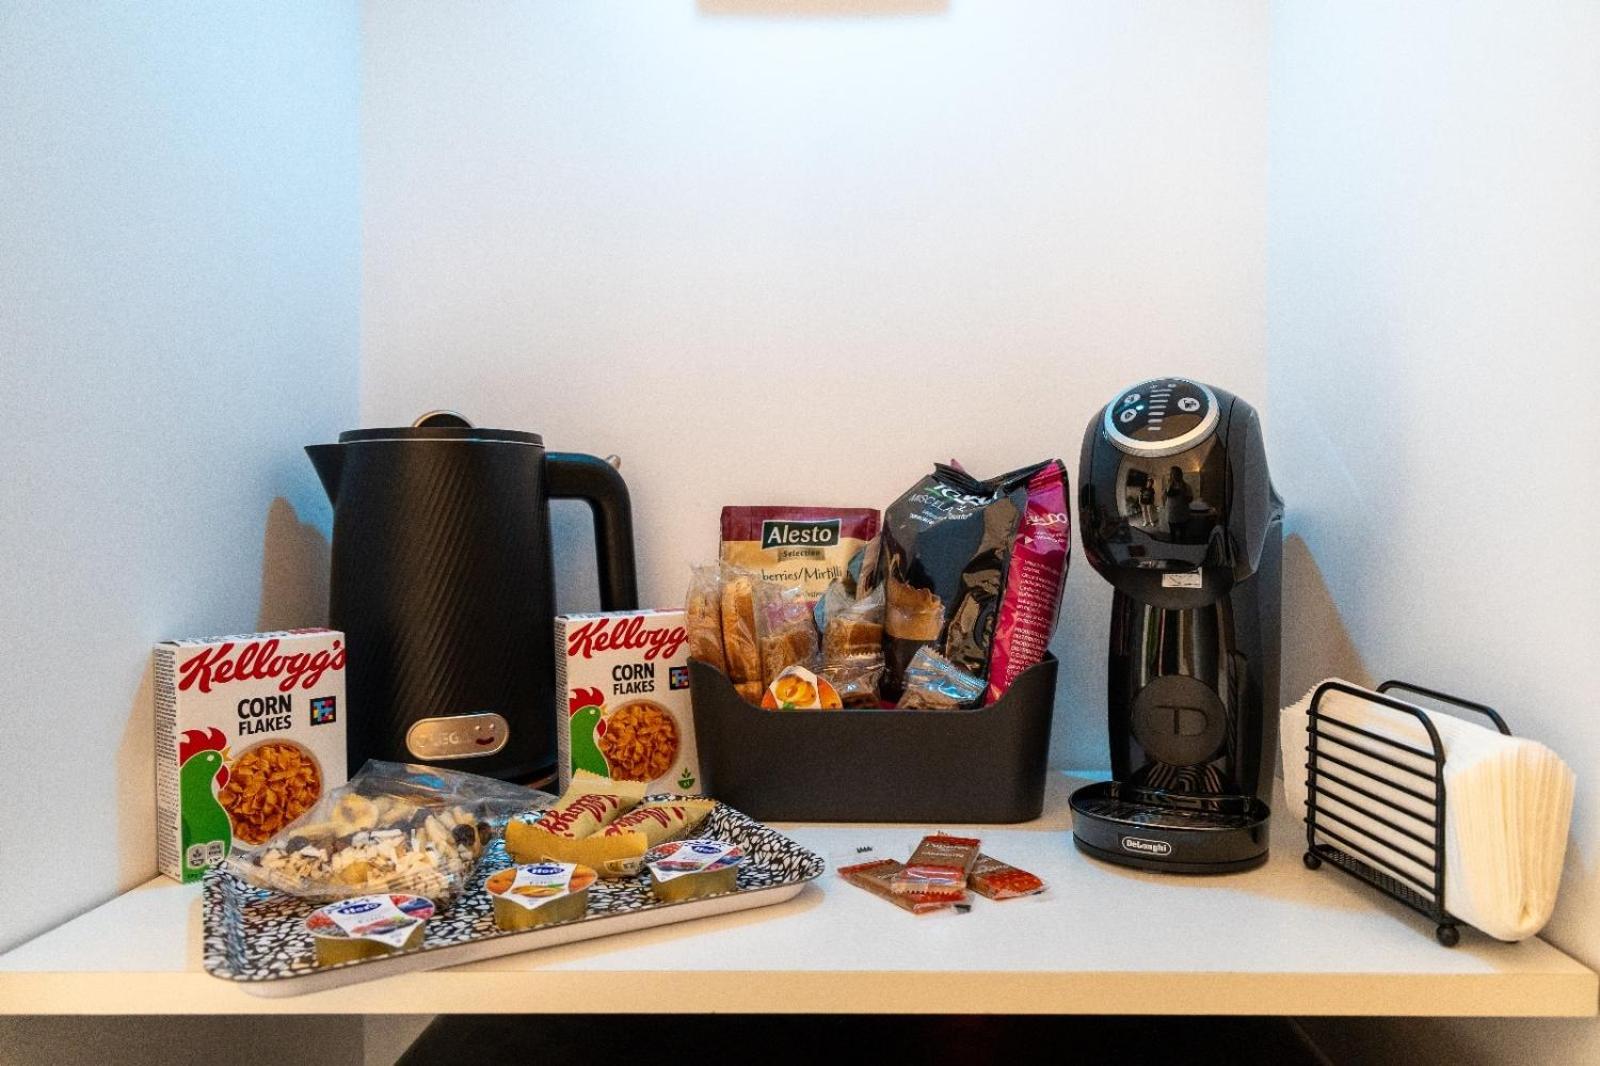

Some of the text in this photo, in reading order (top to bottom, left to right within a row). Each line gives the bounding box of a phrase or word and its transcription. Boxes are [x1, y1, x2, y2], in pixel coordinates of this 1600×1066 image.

[767, 524, 832, 544] Alesto
[567, 615, 689, 660] Kellogg
[178, 639, 347, 693] Kellogg's
[611, 663, 655, 682] CORN
[613, 680, 655, 696] FLAKES
[237, 694, 292, 720] CORN
[238, 715, 292, 736] FLAKES
